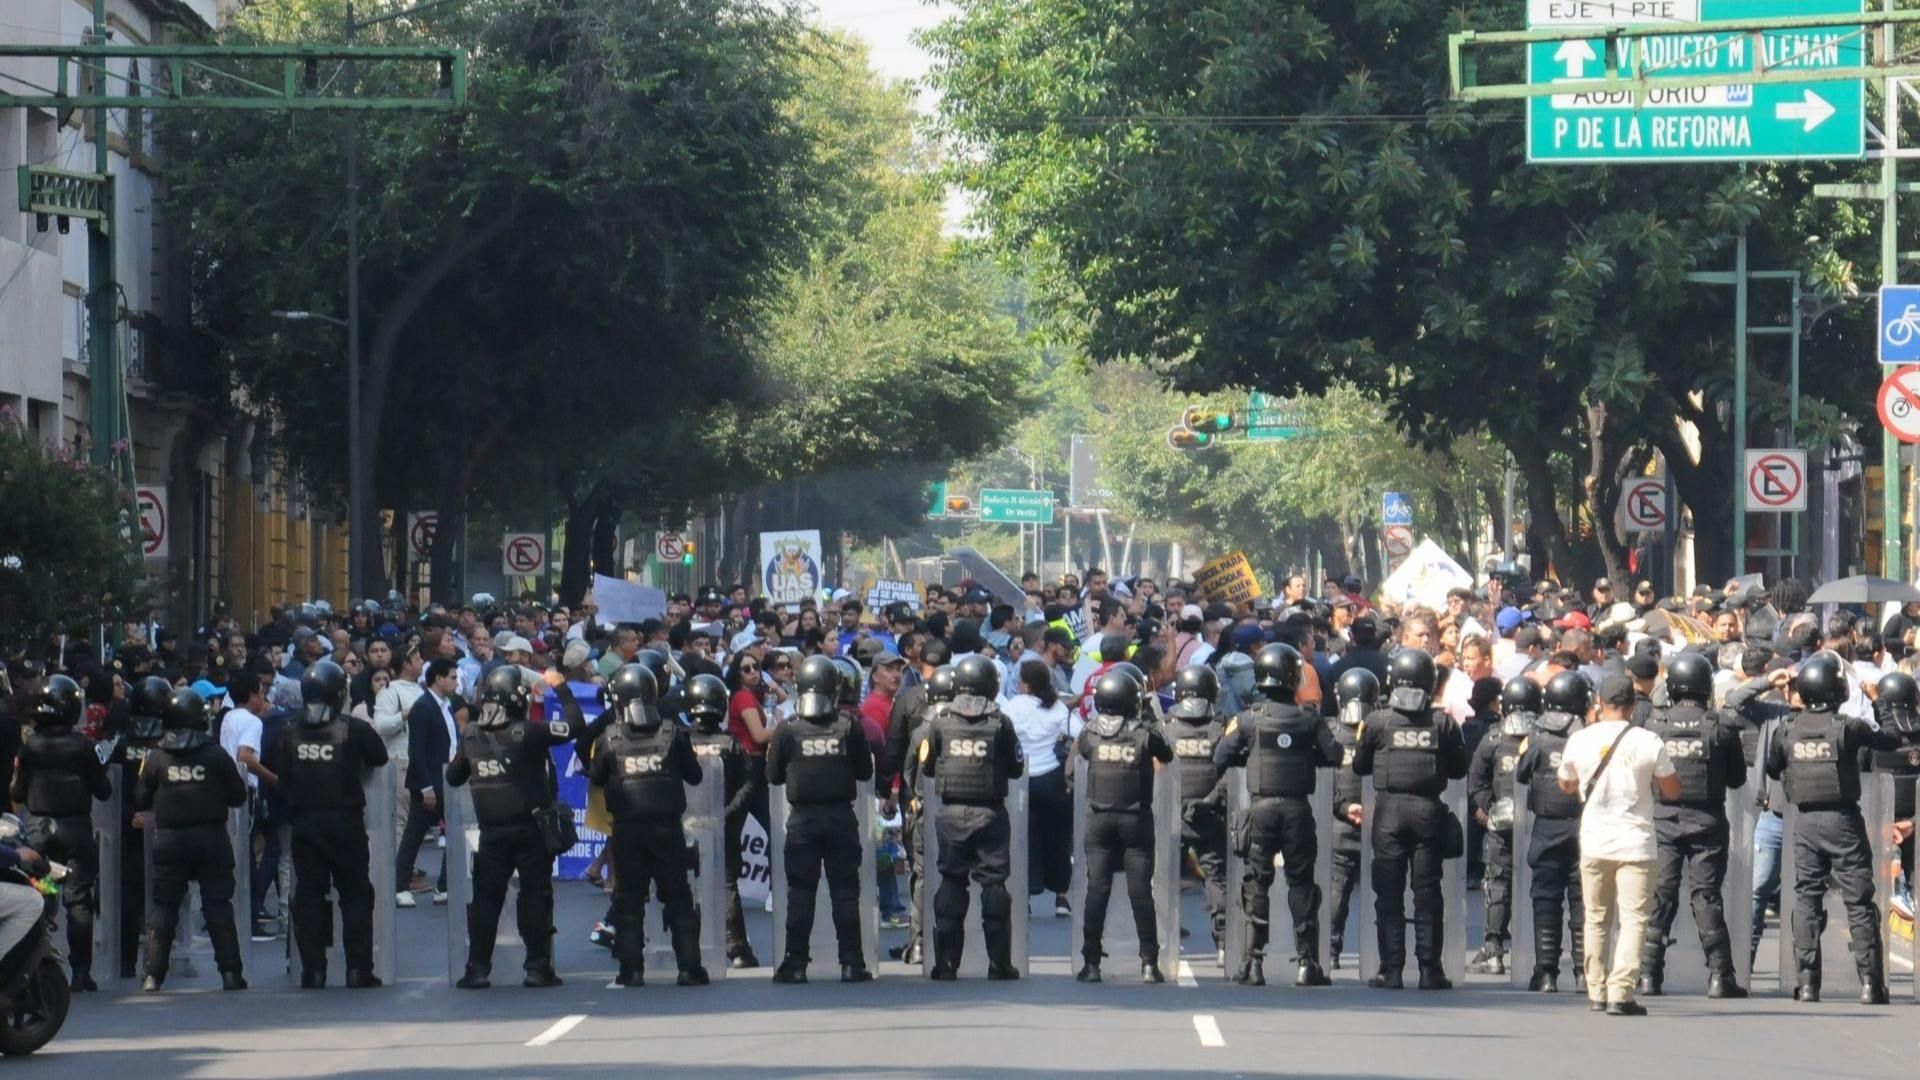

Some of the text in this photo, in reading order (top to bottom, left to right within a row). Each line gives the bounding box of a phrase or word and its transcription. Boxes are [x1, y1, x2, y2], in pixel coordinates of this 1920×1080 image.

[1549, 2, 1675, 18] EJE 1 PTE
[1728, 35, 1744, 67] M
[1573, 85, 1706, 105] AUDIORIO
[1554, 115, 1751, 148] P DE LA REFORMA
[772, 573, 813, 591] UAS
[876, 579, 913, 593] ROCHA
[802, 739, 840, 756] SSC
[949, 739, 987, 757] SSC
[1175, 739, 1211, 756] SSC
[1392, 730, 1432, 748] SSC
[126, 746, 152, 760] SS
[297, 743, 334, 760] SSC
[692, 743, 721, 756] SC
[1097, 743, 1136, 762] SSC
[1664, 740, 1704, 758] SSC
[1793, 741, 1831, 759] SSC
[624, 754, 662, 774] SSC
[167, 765, 206, 782] SSC
